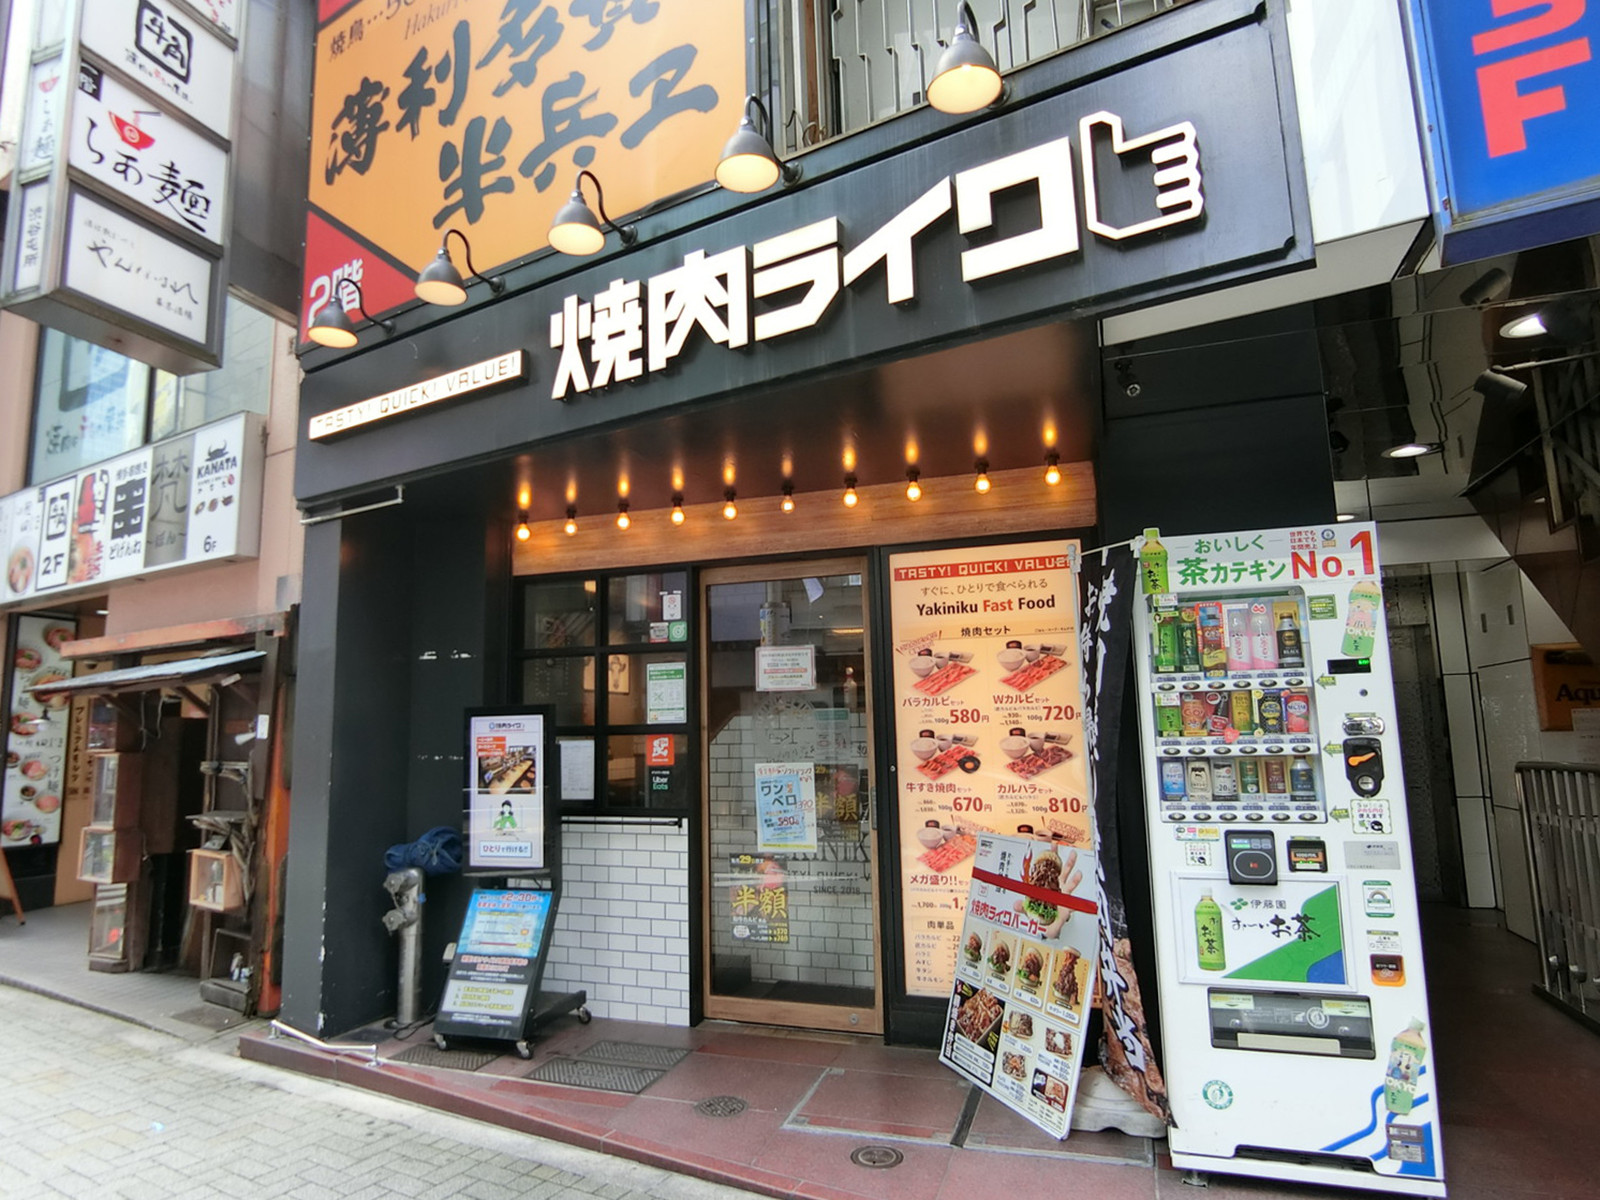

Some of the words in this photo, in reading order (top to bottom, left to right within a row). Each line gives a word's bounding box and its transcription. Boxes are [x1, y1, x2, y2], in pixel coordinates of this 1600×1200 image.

[550, 136, 1080, 400] 焼肉ライク
[379, 383, 437, 415] QUICK!
[446, 355, 516, 393] VALUE!
[197, 456, 238, 480] KANATA
[203, 535, 217, 553] 6F
[1194, 534, 1265, 554] おいしく
[42, 552, 65, 576] 2F
[1291, 530, 1375, 580] No.1
[899, 566, 952, 580] TASTY!
[958, 562, 1008, 576] QUICK!
[1177, 556, 1287, 586] 茶カテキン
[920, 578, 1048, 596] すぐに、ひとりで食べられる
[916, 601, 979, 616] Yakiniku
[982, 598, 1014, 612] Fast
[1018, 594, 1056, 610] Food
[961, 625, 1011, 637] 焼肉セット
[652, 775, 669, 784] Uber
[652, 783, 670, 791] Eats
[760, 783, 784, 796] ワン
[771, 794, 797, 806] ベロ
[813, 885, 839, 894] SINCE
[731, 884, 787, 919] 半額
[1250, 899, 1287, 910] 伊藤園
[926, 920, 955, 930] 肉単品
[970, 898, 1047, 936] 焼肉ライクバーガー
